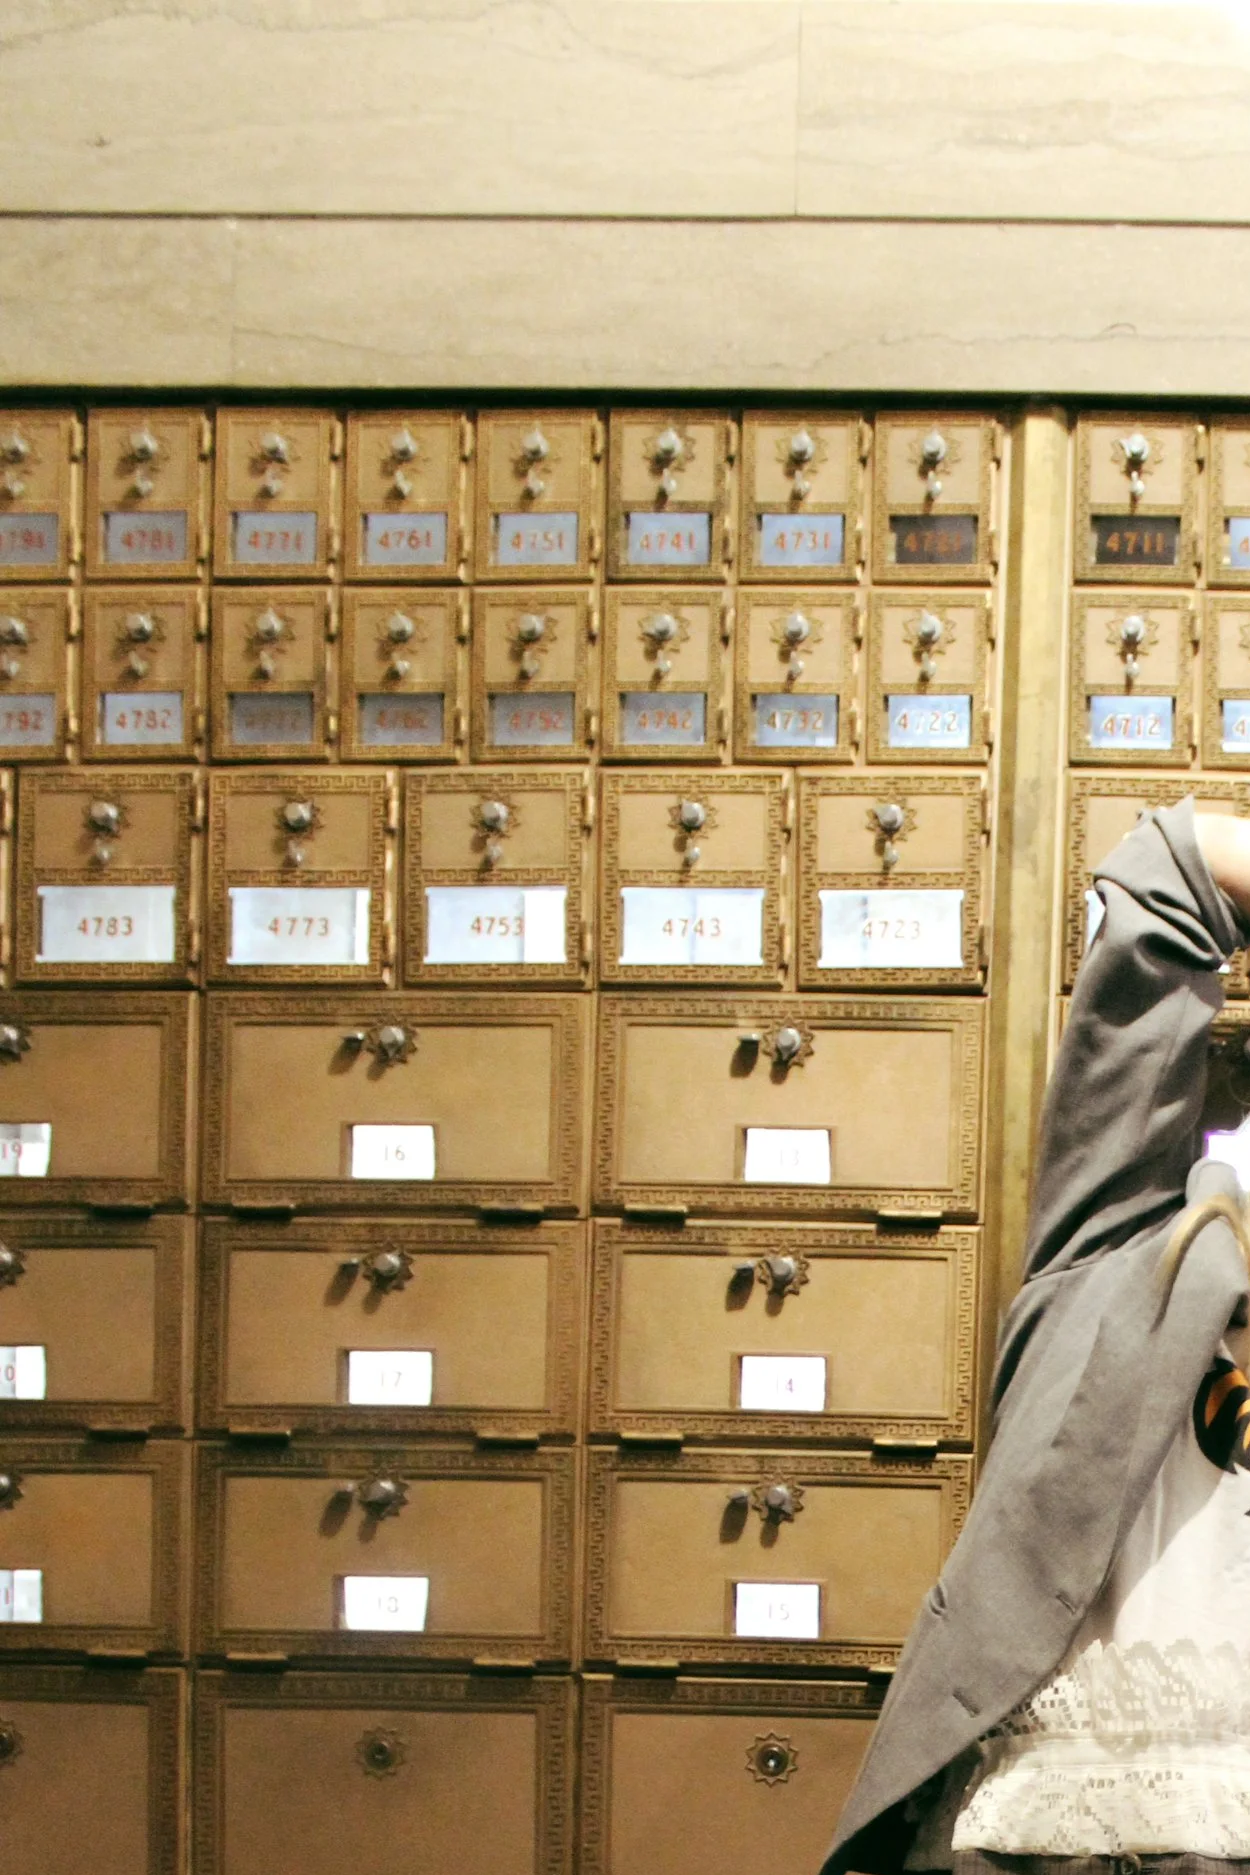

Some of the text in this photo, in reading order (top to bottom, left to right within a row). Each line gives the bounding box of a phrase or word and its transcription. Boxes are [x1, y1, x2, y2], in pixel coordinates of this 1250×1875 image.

[0, 531, 46, 550] 791
[248, 531, 303, 551] 4771
[378, 530, 433, 550] 4761
[511, 531, 565, 551] 4751
[640, 531, 696, 551] 4741
[775, 531, 830, 551] 4731
[1106, 532, 1165, 553] 4711
[116, 710, 171, 729] 4782
[638, 710, 693, 730] 4742
[765, 709, 823, 730] 4732
[897, 711, 958, 732] 4722
[1101, 716, 1160, 736] 4712
[77, 917, 133, 936] 4783
[268, 917, 329, 936] 4773
[471, 916, 524, 936] 4753
[662, 918, 722, 938] 4743
[862, 920, 921, 940] 4723
[384, 1145, 405, 1163] 16
